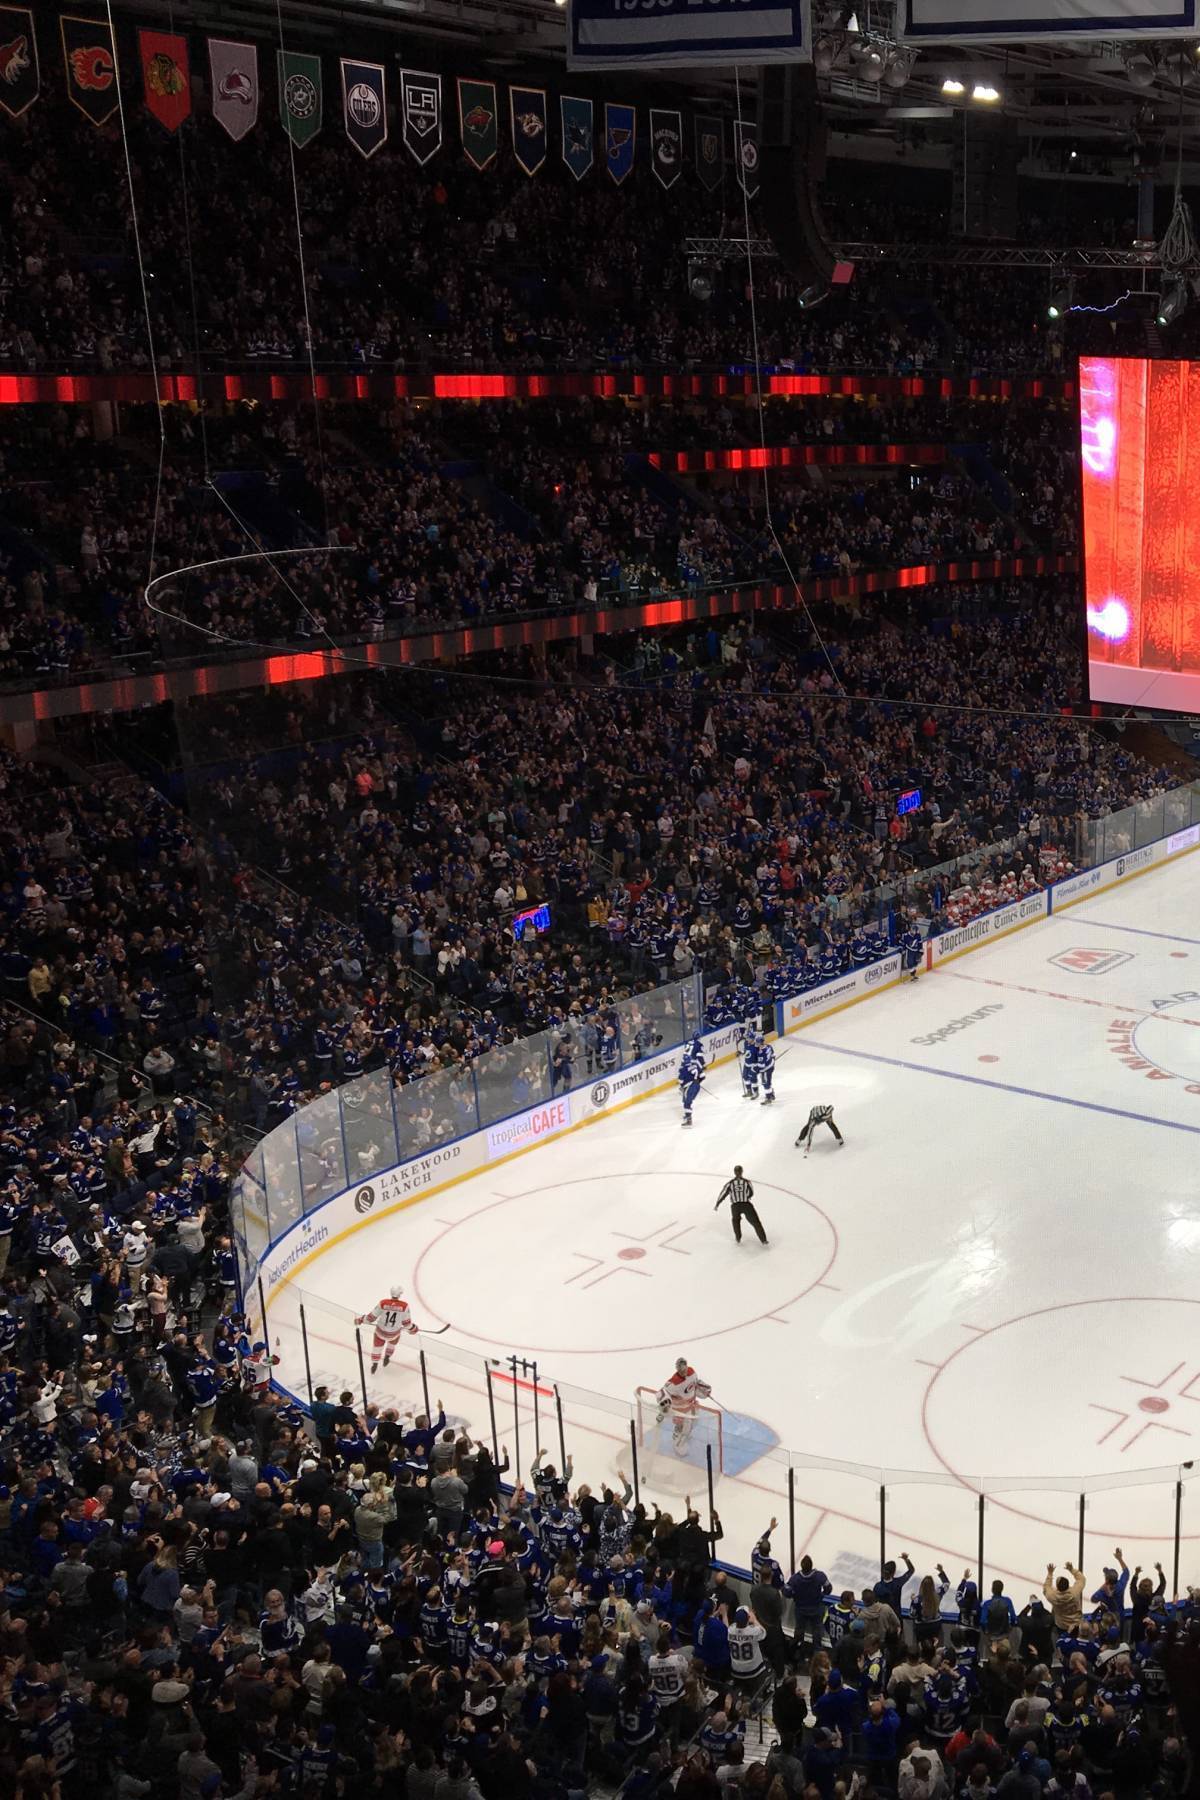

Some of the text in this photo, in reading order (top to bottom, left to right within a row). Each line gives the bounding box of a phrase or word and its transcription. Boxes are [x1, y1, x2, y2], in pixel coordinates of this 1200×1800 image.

[408, 91, 434, 109] LA
[993, 899, 1042, 929] Times Times
[867, 959, 898, 980] FOX SUN
[910, 1003, 998, 1047] Spectrum
[709, 1032, 731, 1052] Hard
[1105, 1018, 1176, 1081] AMALIE
[612, 1072, 643, 1095] JIMMY
[645, 1057, 676, 1082] JOHN'S
[491, 1118, 532, 1147] tropical
[531, 1103, 566, 1135] CAFE
[380, 1146, 462, 1189] LAKEWOOD
[381, 1172, 432, 1202] RANCH
[267, 1225, 329, 1286] AdventHealth
[384, 1310, 398, 1327] 14
[654, 1674, 679, 1691] 86
